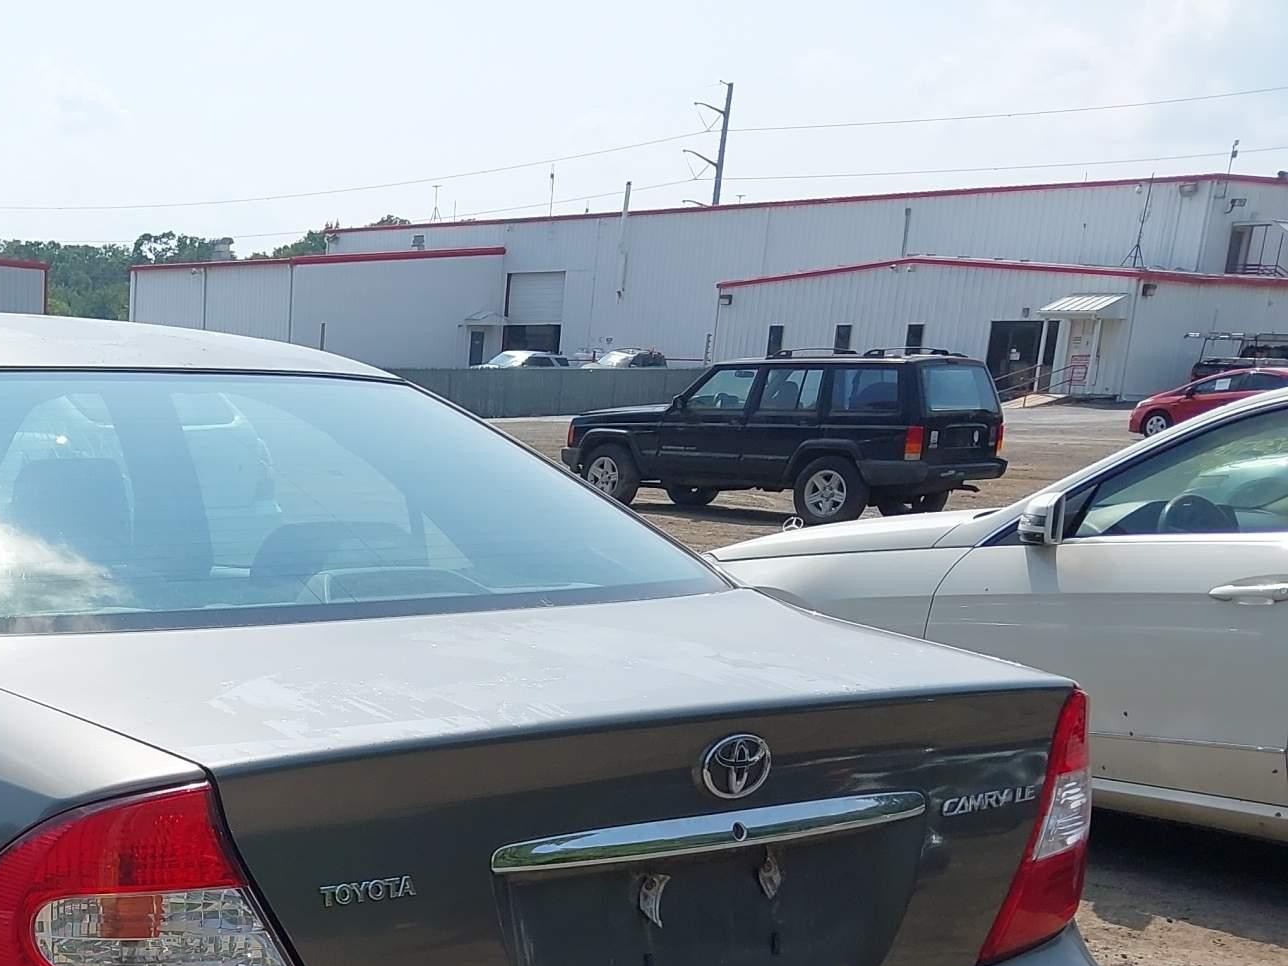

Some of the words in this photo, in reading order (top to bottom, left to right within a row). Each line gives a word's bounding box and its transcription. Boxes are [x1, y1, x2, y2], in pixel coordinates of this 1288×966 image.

[942, 787, 1011, 816] CAMRY
[1014, 785, 1036, 803] LE
[319, 875, 417, 907] TOYOTA
